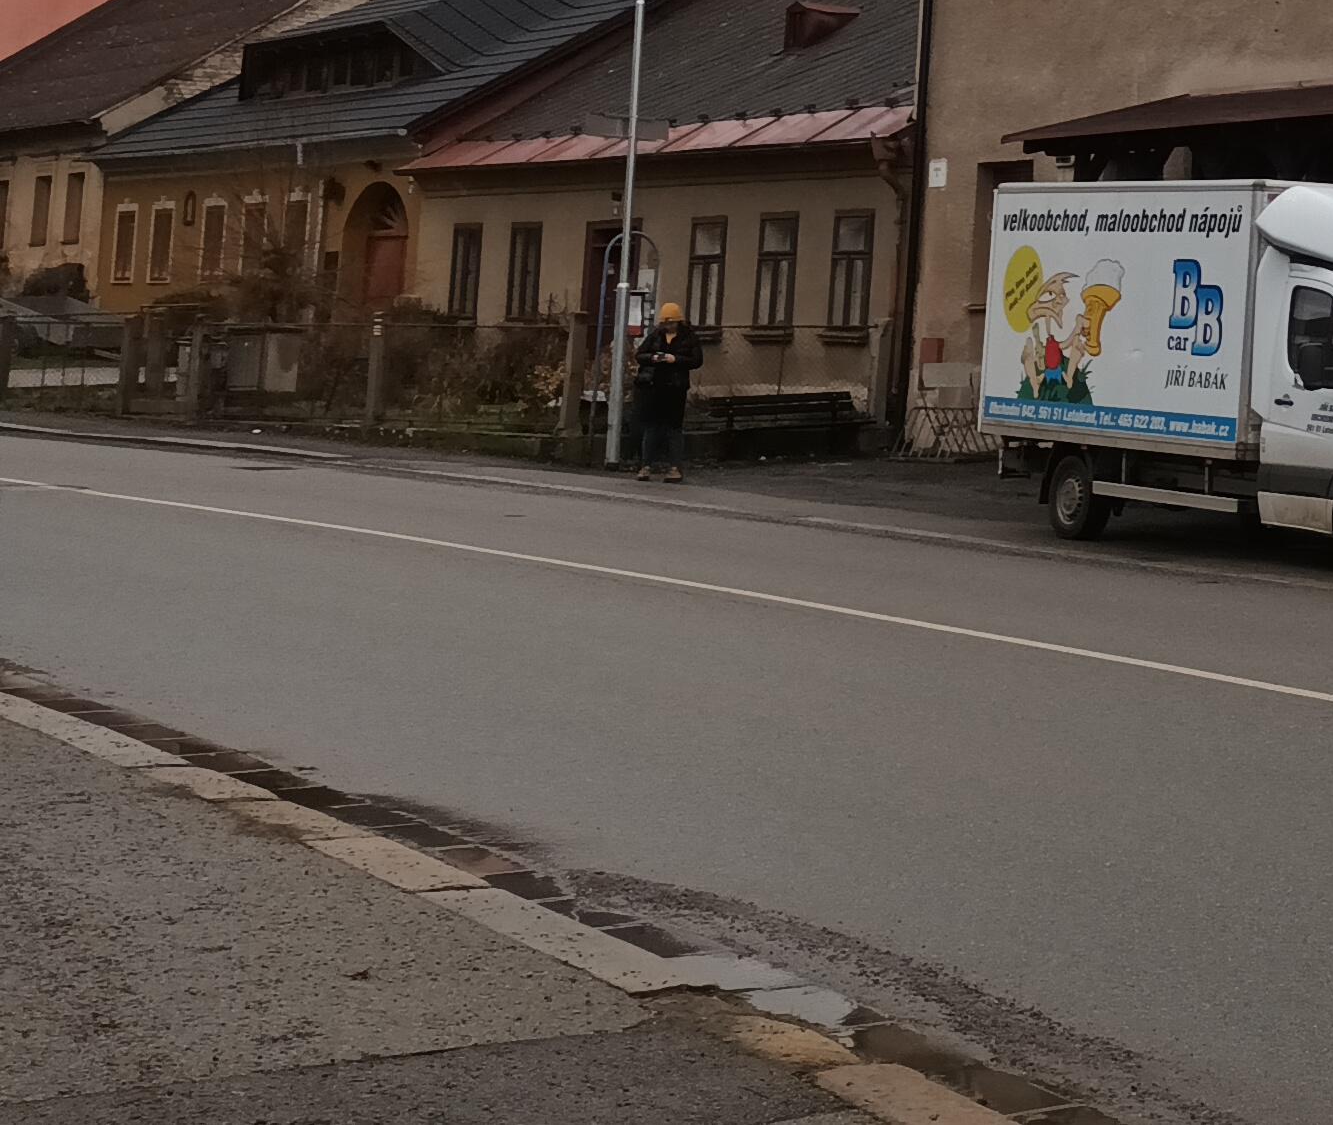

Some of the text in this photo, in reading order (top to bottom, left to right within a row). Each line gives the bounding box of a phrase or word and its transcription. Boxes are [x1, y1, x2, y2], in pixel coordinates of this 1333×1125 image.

[1003, 204, 1243, 238] velkoobchod, maloobchod nápojů
[1167, 334, 1189, 351] car
[1165, 364, 1228, 390] JIŘÍ BABÁK
